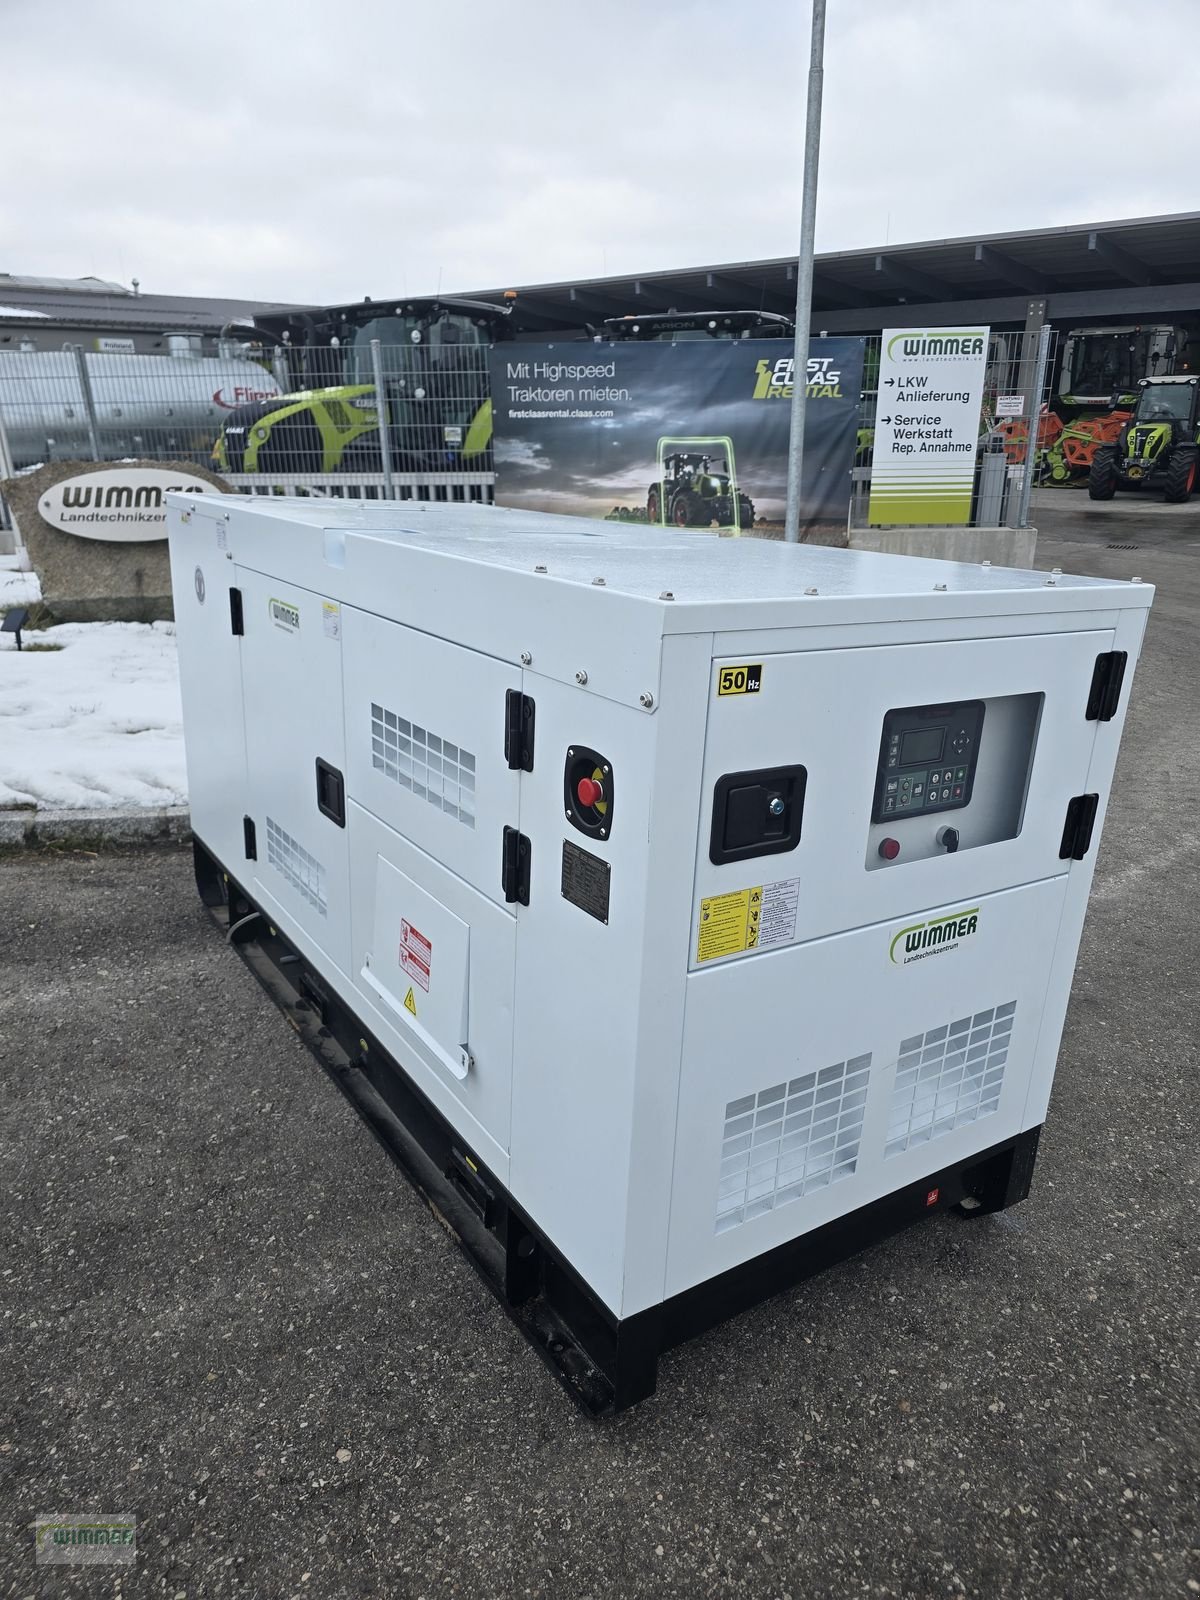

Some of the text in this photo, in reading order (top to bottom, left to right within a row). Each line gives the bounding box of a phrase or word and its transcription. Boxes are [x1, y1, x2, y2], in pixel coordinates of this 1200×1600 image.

[903, 338, 984, 356] WIMMER
[507, 361, 616, 381] Mit Highspeed
[774, 358, 834, 372] FIST
[771, 371, 841, 386] CLAS
[898, 376, 928, 388] LKW
[507, 385, 633, 402] Traktoren mieten.
[767, 384, 844, 399] RETAL
[896, 390, 970, 404] Anlieferung
[508, 409, 614, 419] firstclaasrental.claas.com
[894, 415, 942, 426] Service
[893, 428, 953, 439] Werkstatt
[892, 441, 973, 455] Rep. Annahme
[62, 486, 204, 508] WIMM
[722, 671, 760, 690] 50 Hz
[905, 915, 978, 953] WIMMER
[903, 942, 959, 965] Landtechnikzentrum
